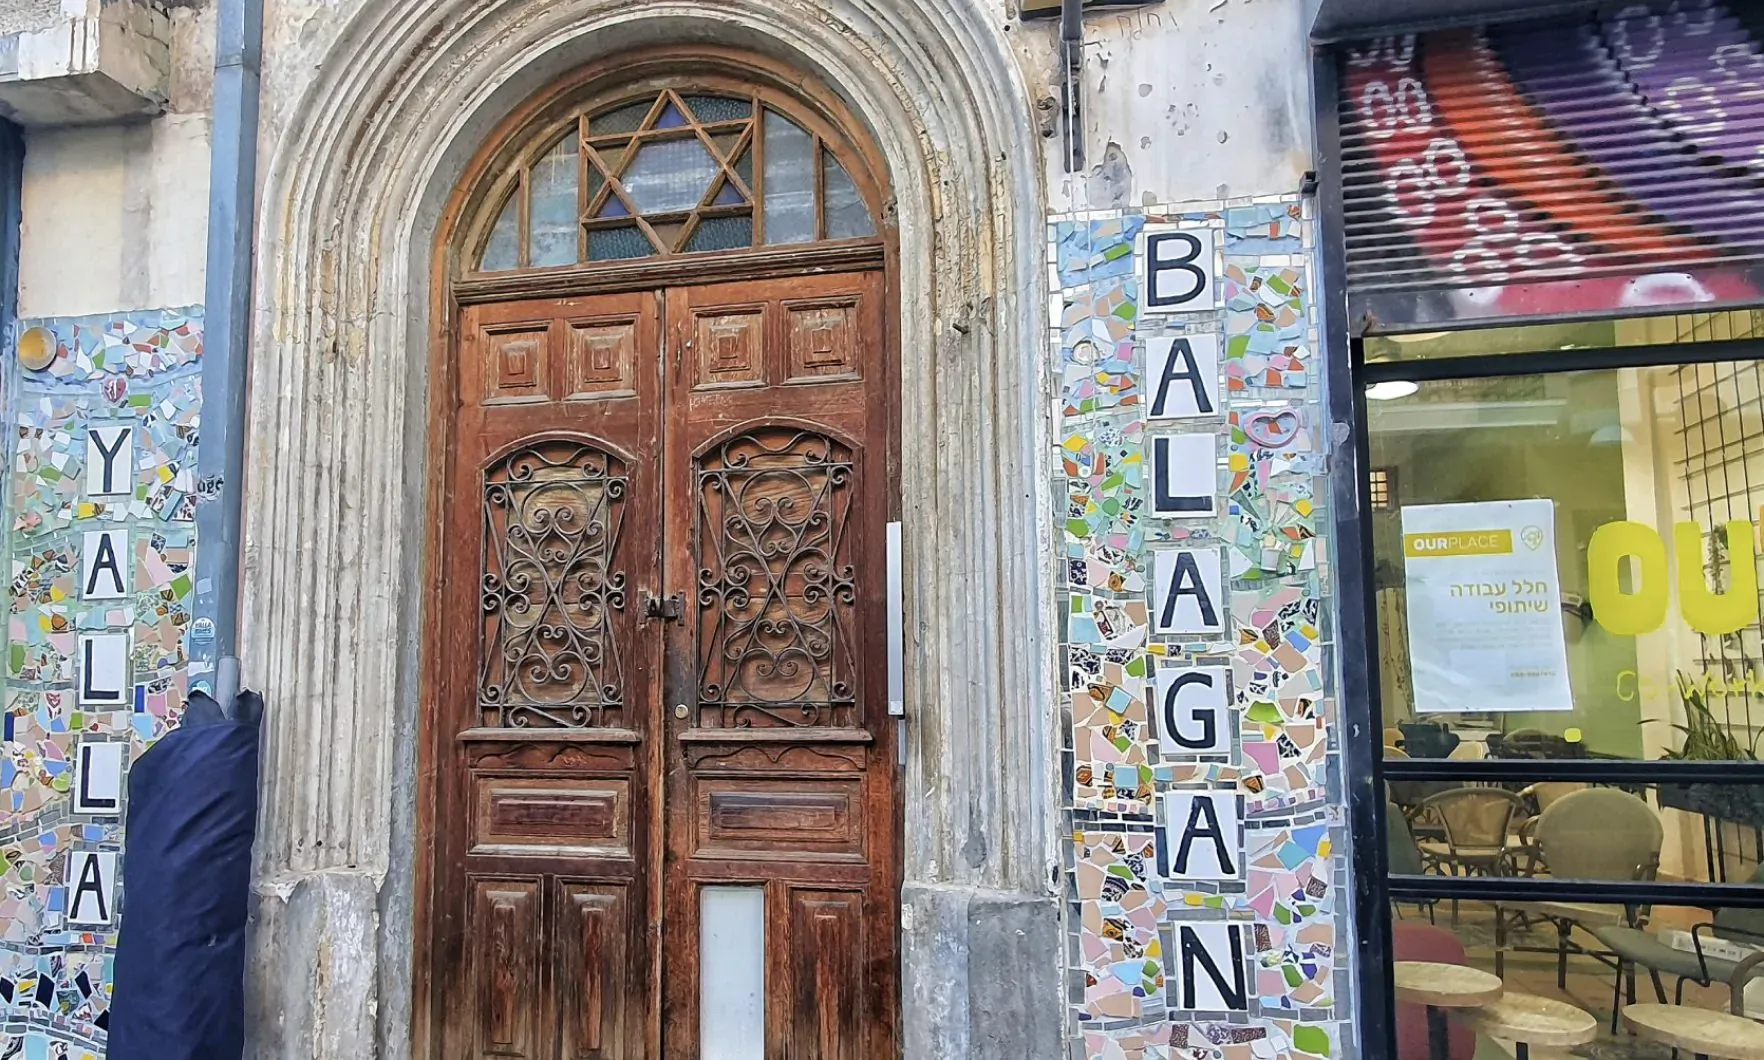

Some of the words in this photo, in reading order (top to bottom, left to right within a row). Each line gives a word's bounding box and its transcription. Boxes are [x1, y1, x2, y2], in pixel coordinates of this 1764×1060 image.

[1413, 534, 1499, 551] OURPLACE
[1450, 582, 1506, 597] עבודה
[1511, 579, 1548, 594] חלל
[1489, 600, 1548, 613] שיתופי
[1145, 231, 1248, 1013] BALAGAN
[69, 427, 133, 922] YALLA
